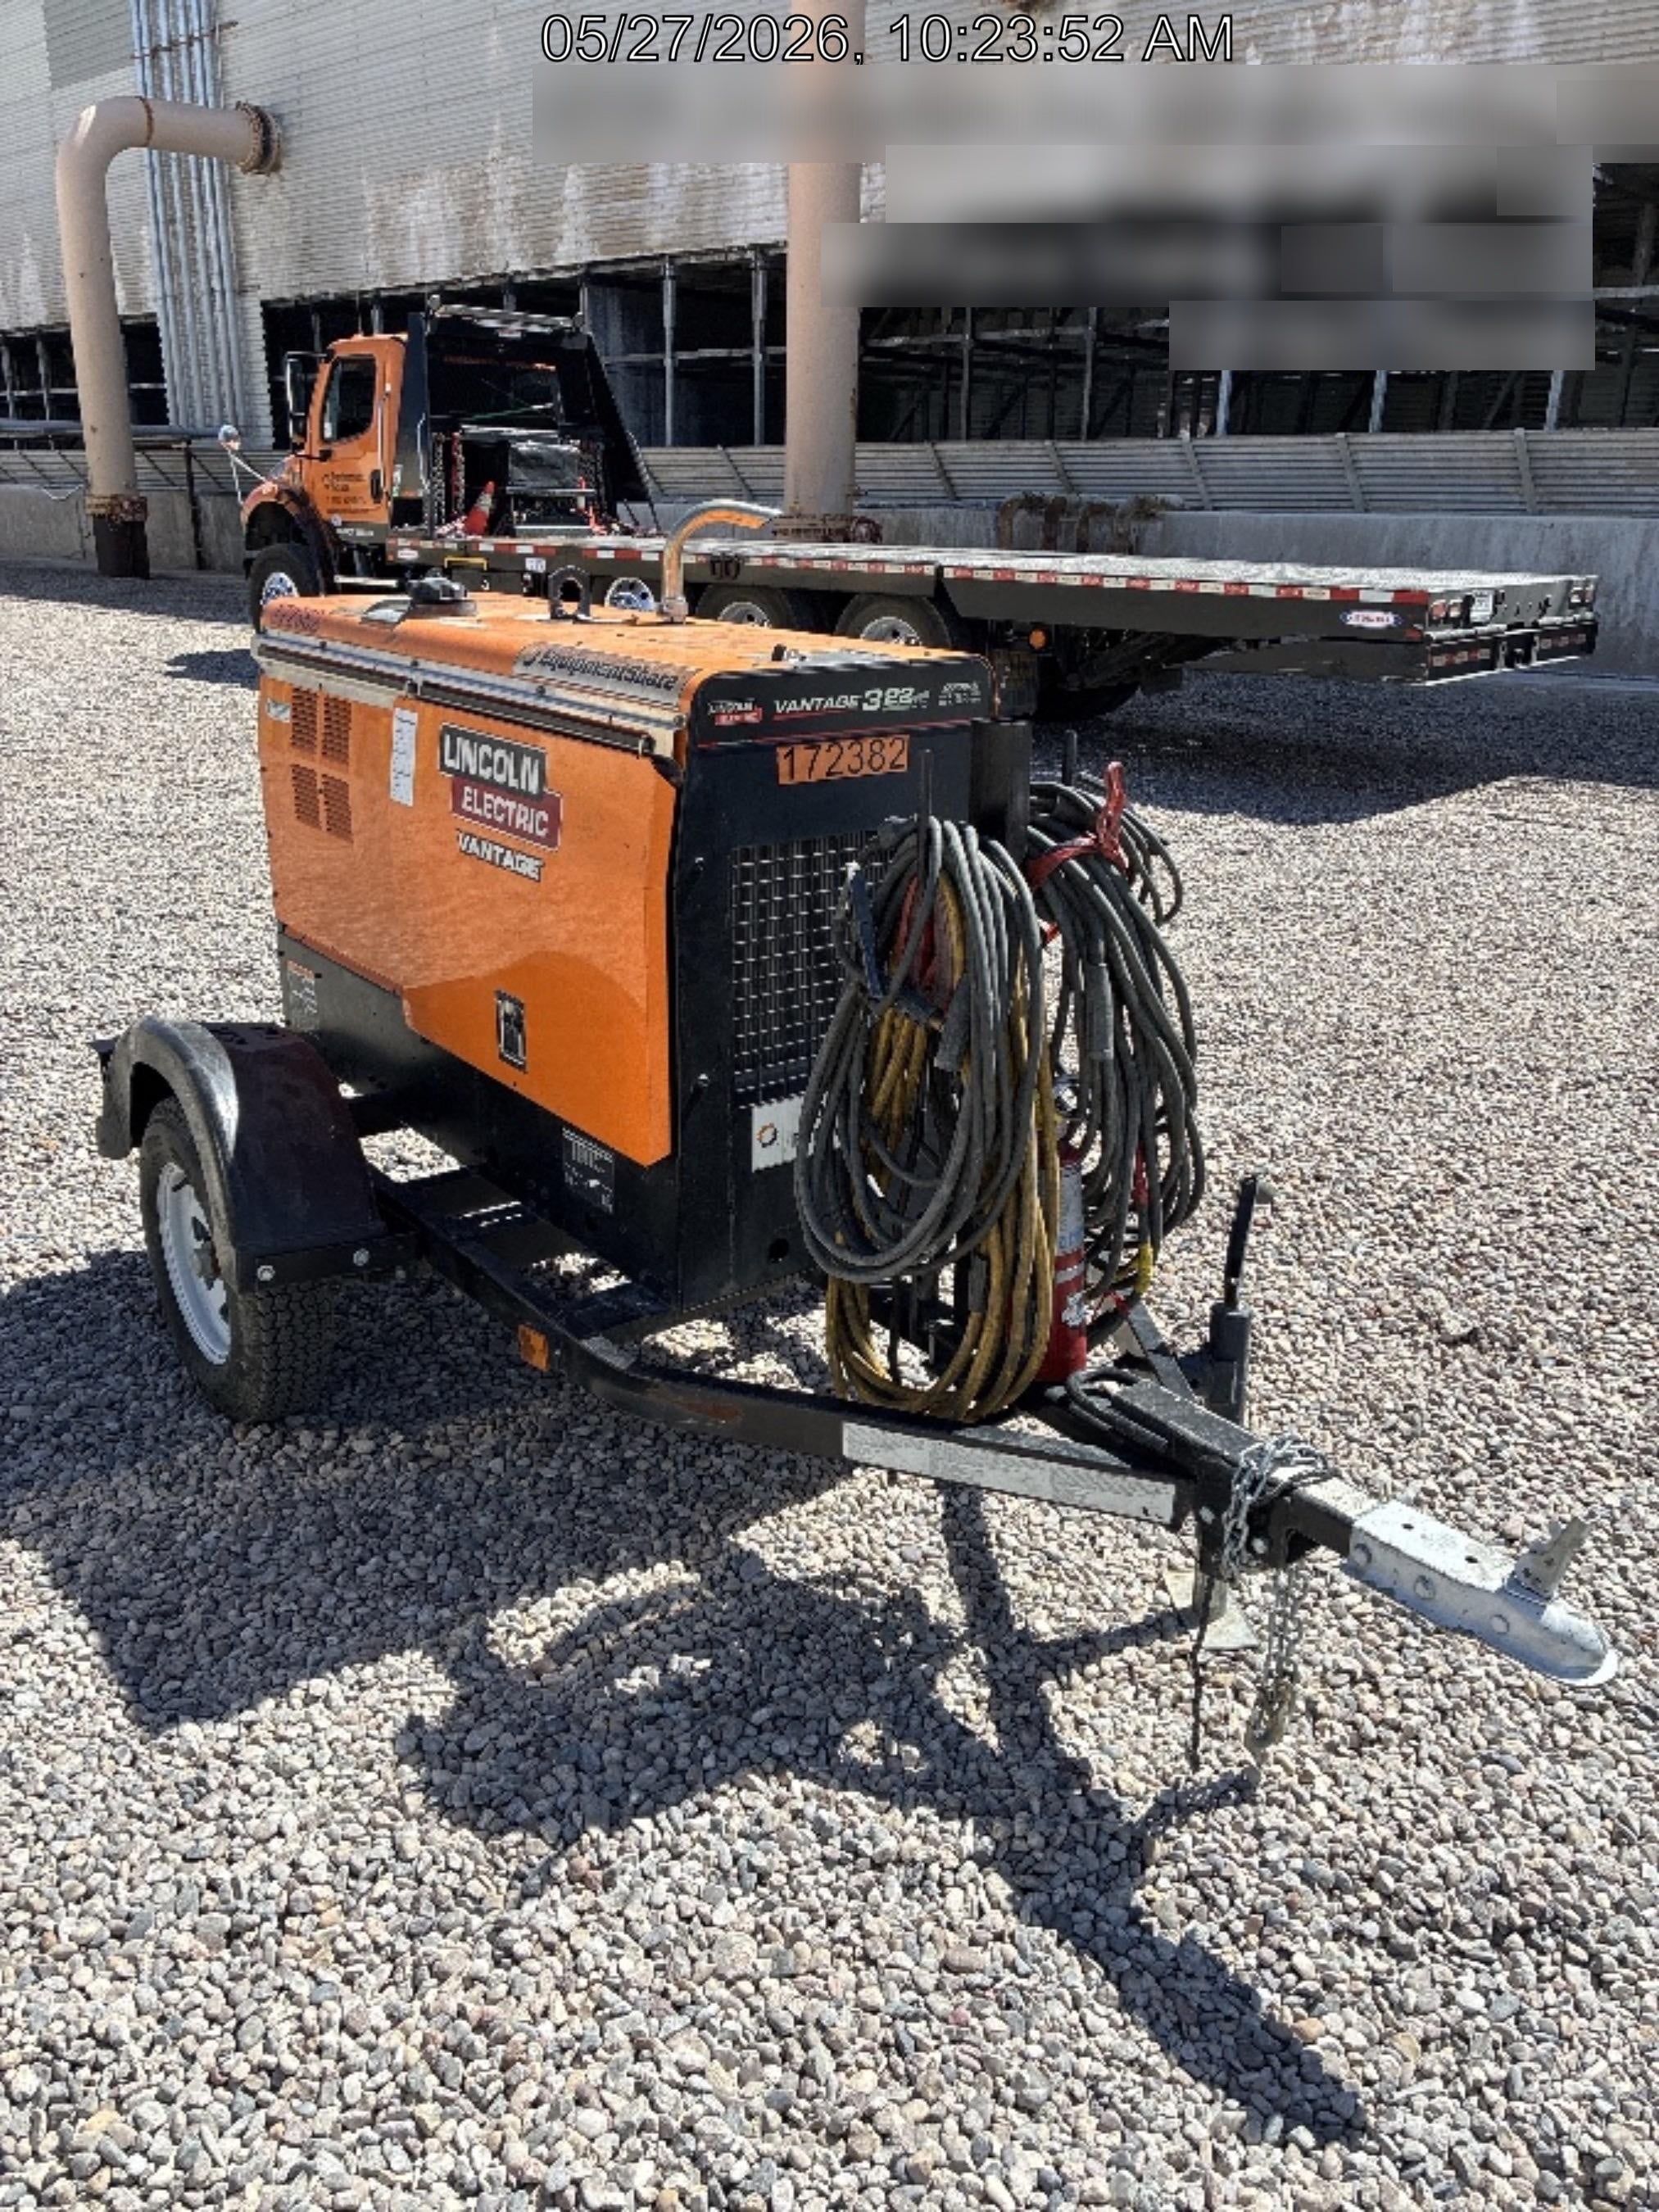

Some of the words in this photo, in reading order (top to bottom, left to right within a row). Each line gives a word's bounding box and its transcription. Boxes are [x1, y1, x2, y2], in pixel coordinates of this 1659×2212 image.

[774, 695, 861, 714] VANTAGE
[443, 733, 540, 796] LINCOLN
[783, 737, 906, 781] 172382
[460, 785, 549, 838] ELECTRIC
[457, 830, 545, 881] VANTAGE
